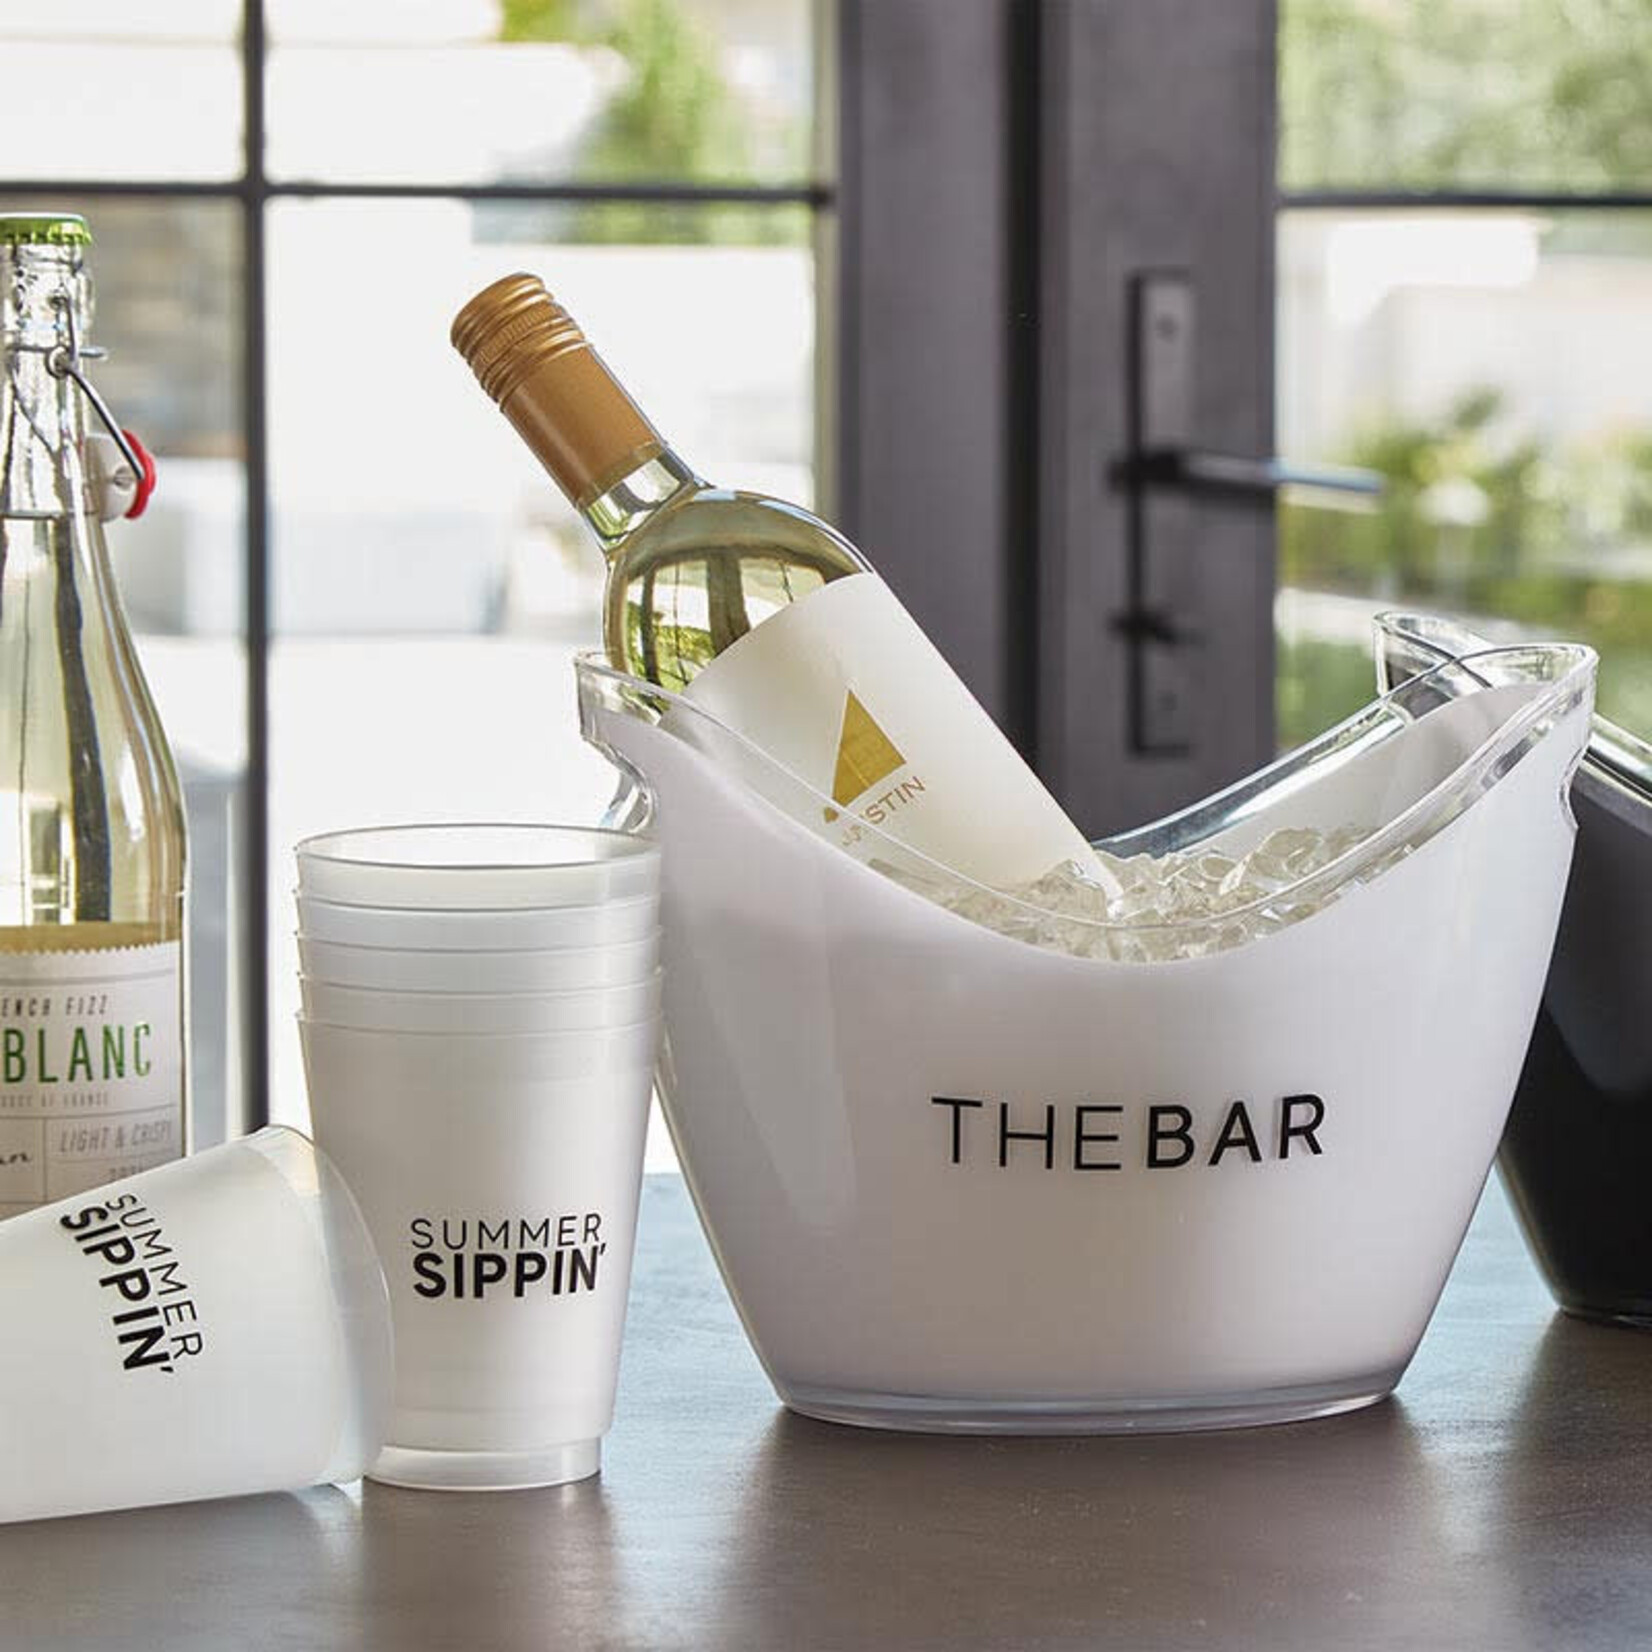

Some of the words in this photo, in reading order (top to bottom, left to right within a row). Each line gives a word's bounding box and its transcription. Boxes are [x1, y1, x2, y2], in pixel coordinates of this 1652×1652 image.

[3, 1023, 151, 1083] BLANC
[410, 1213, 602, 1250] SUMMER
[60, 1206, 174, 1373] SIPPIN'
[105, 1193, 203, 1360] SUMMER
[413, 1242, 606, 1299] SIPPIN'
